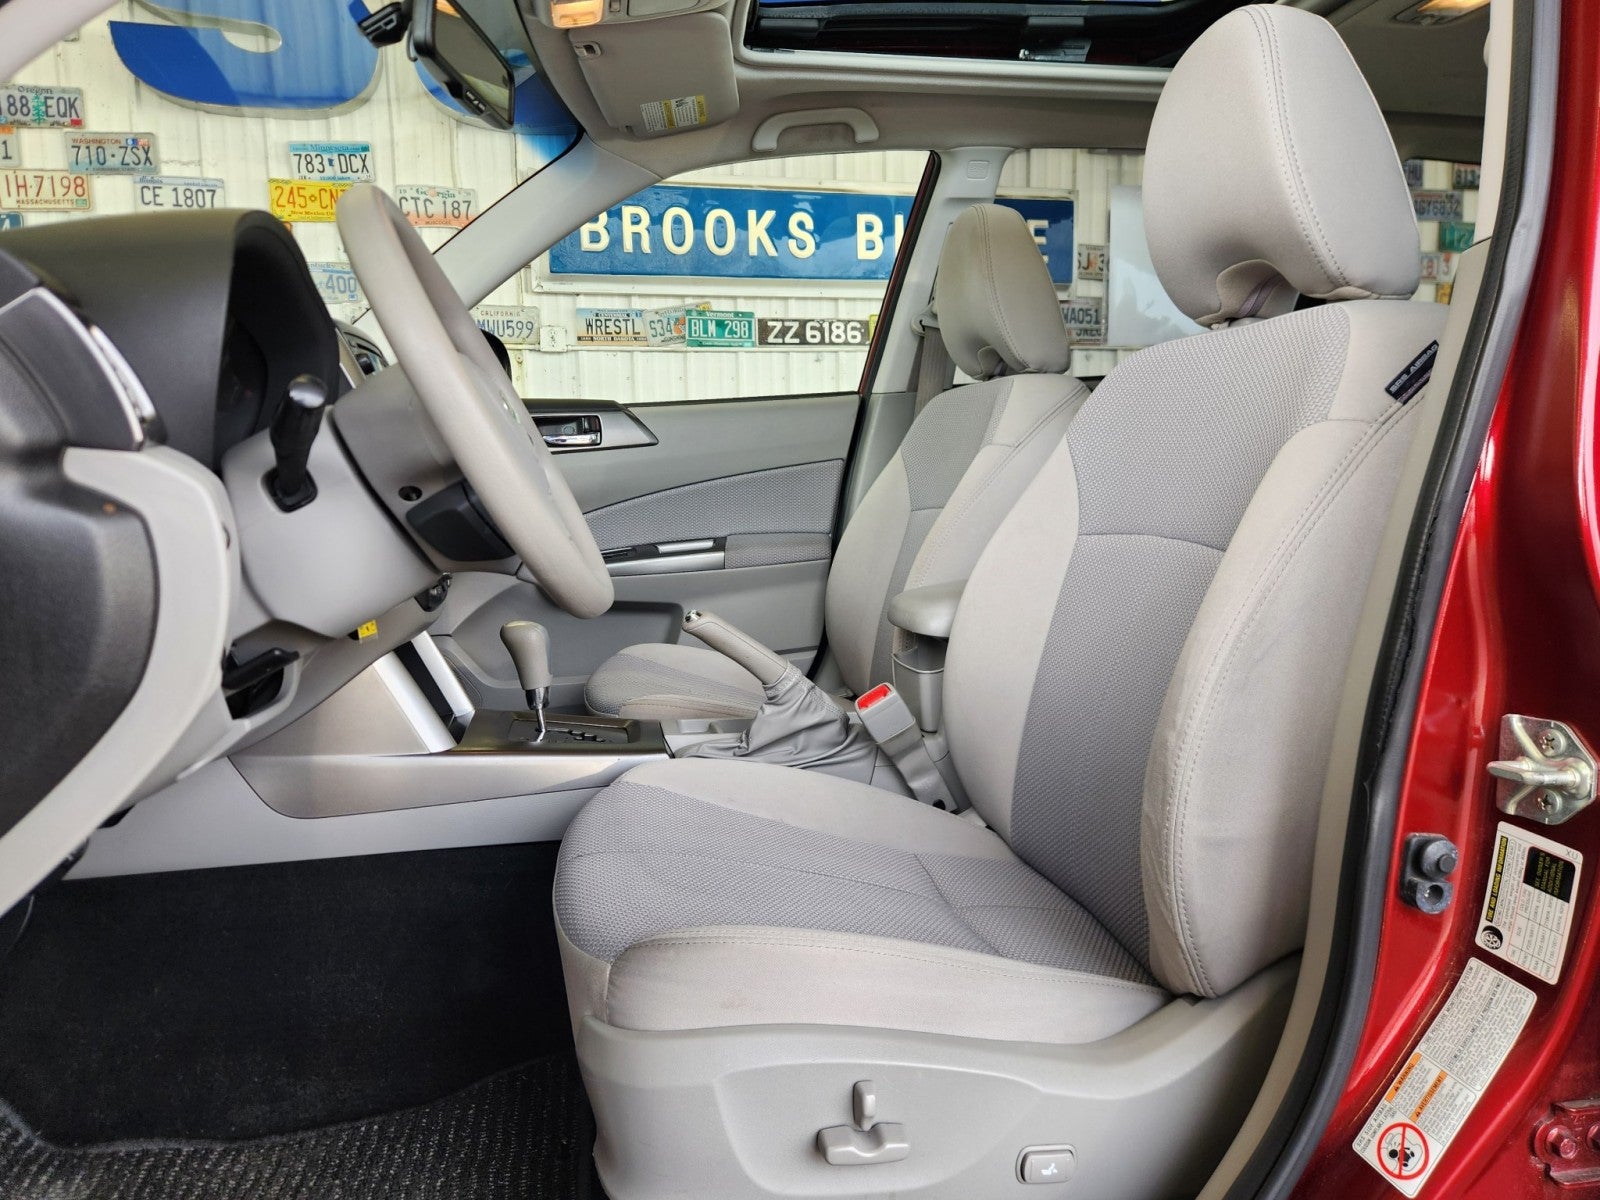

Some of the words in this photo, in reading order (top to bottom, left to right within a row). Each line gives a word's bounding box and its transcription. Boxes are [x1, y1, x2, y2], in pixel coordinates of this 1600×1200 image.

[18, 86, 53, 95] Oregon
[44, 96, 80, 118] EQK
[310, 144, 348, 152] Minnesota
[293, 153, 325, 174] 783
[338, 153, 370, 174] DCX
[141, 185, 163, 206] CE
[172, 187, 216, 208] 1807
[275, 186, 307, 208] 245
[319, 188, 347, 210] CN
[399, 197, 434, 219] CTC
[443, 200, 471, 220] 187
[580, 205, 817, 259] BROOKS
[585, 318, 641, 335] WRESTL
[692, 319, 716, 337] BLM
[724, 321, 749, 338] 298
[767, 321, 800, 344] ZZ
[805, 321, 862, 344] 6186
[1491, 872, 1501, 896] LOADING
[1496, 836, 1507, 872] INFORMATION
